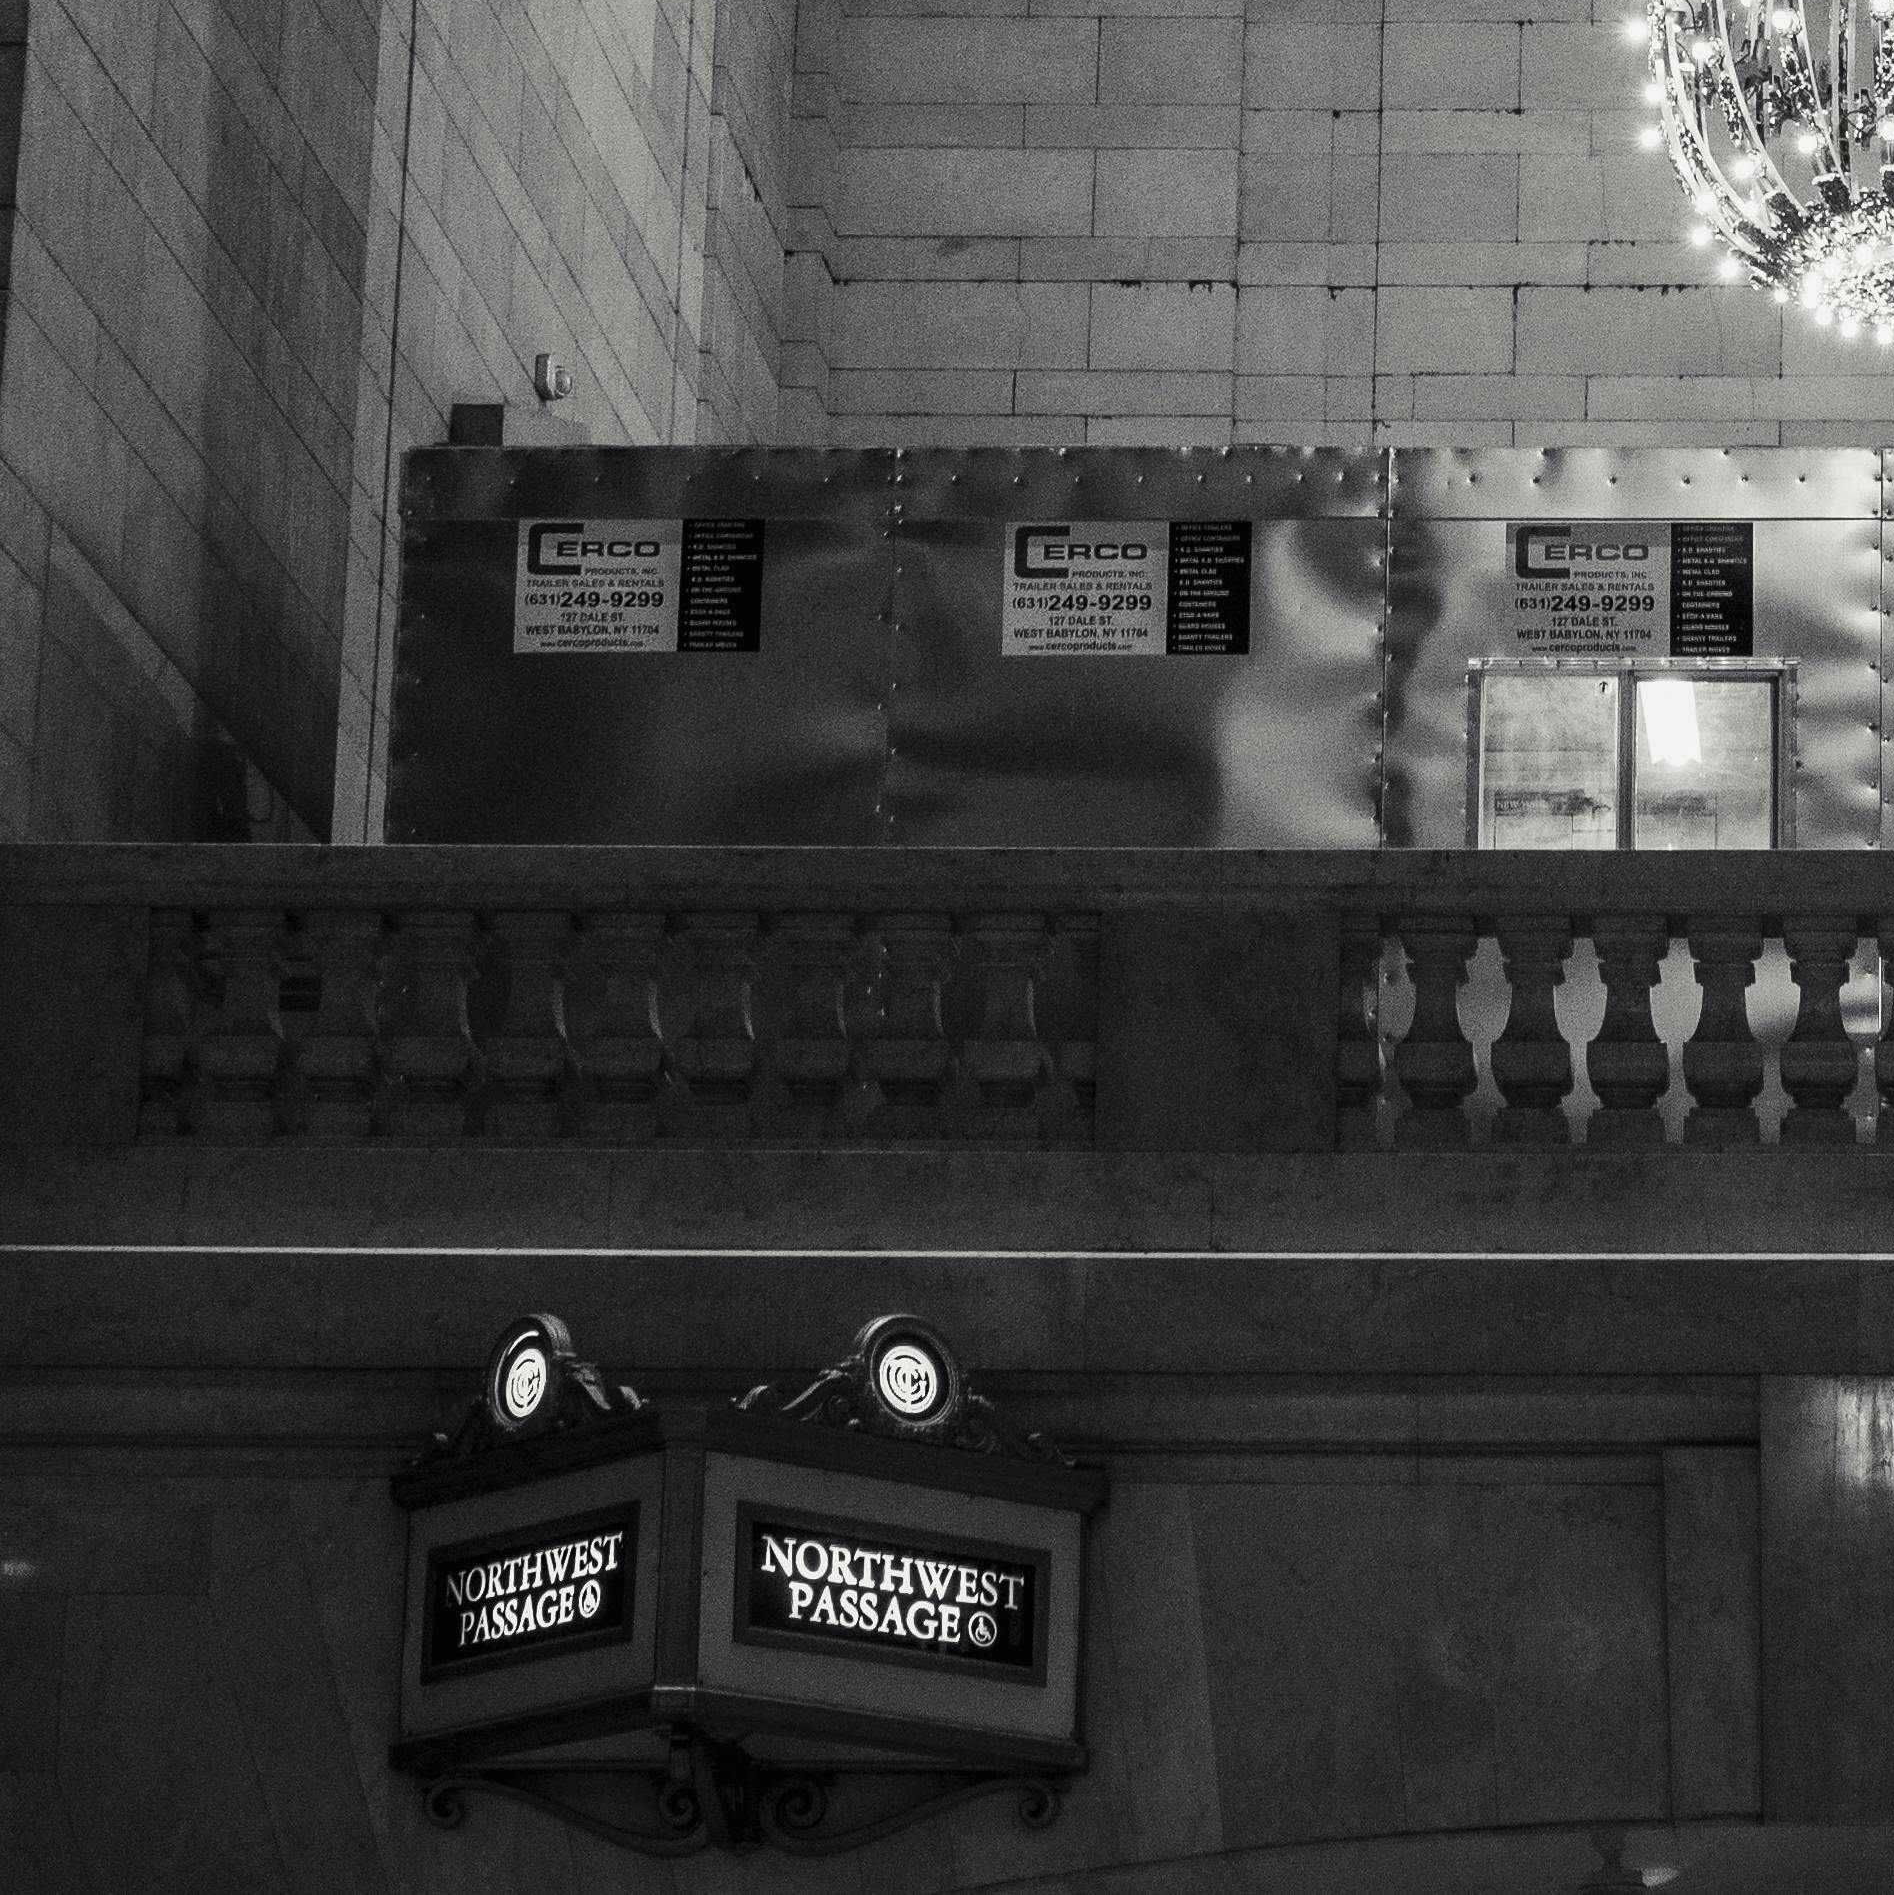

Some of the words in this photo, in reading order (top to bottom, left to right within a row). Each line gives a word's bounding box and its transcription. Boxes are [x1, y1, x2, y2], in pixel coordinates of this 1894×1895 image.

[526, 625, 556, 635] WEST
[1014, 629, 1043, 638] WEST
[1517, 630, 1545, 639] WEST
[445, 1532, 623, 1607] NORTHWEST
[761, 1535, 1025, 1611] NORTHWEST
[459, 1585, 574, 1647] PASSAGE
[787, 1581, 961, 1643] PASSAGE
